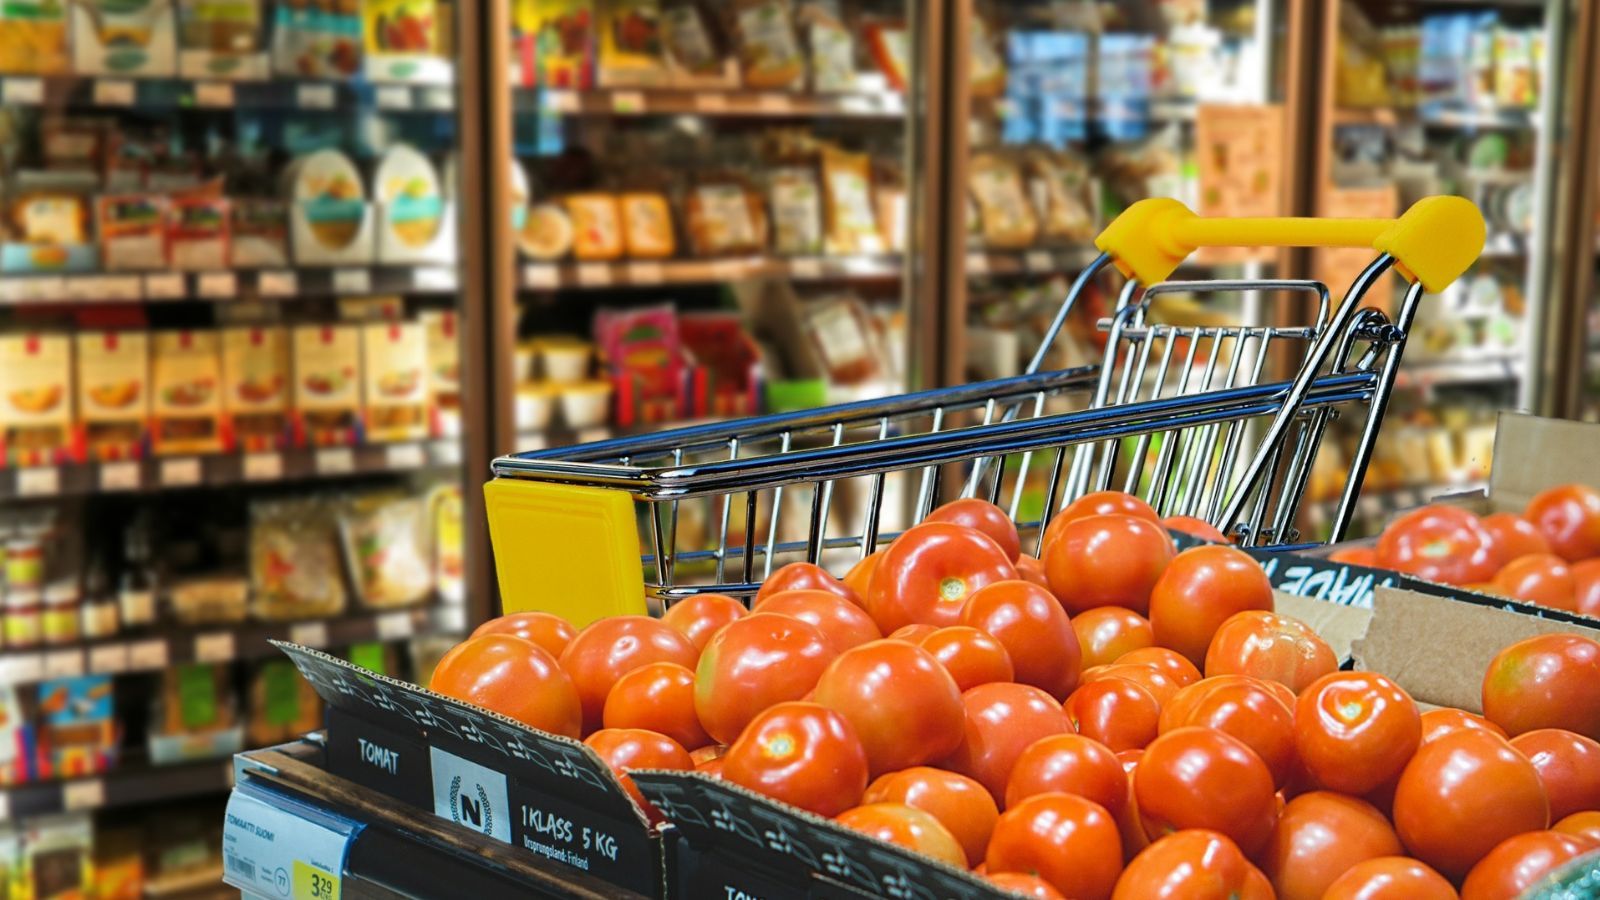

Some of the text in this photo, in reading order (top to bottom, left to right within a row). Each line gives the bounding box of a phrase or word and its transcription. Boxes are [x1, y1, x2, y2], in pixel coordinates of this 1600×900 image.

[358, 738, 399, 775] TOMAT
[227, 813, 256, 833] TOMAATTI
[255, 823, 276, 842] SUOMI
[461, 794, 481, 827] N
[521, 805, 618, 861] 1 KLASS 5 KG
[523, 834, 589, 870] Ursprungsland: Finland
[278, 875, 287, 888] 77
